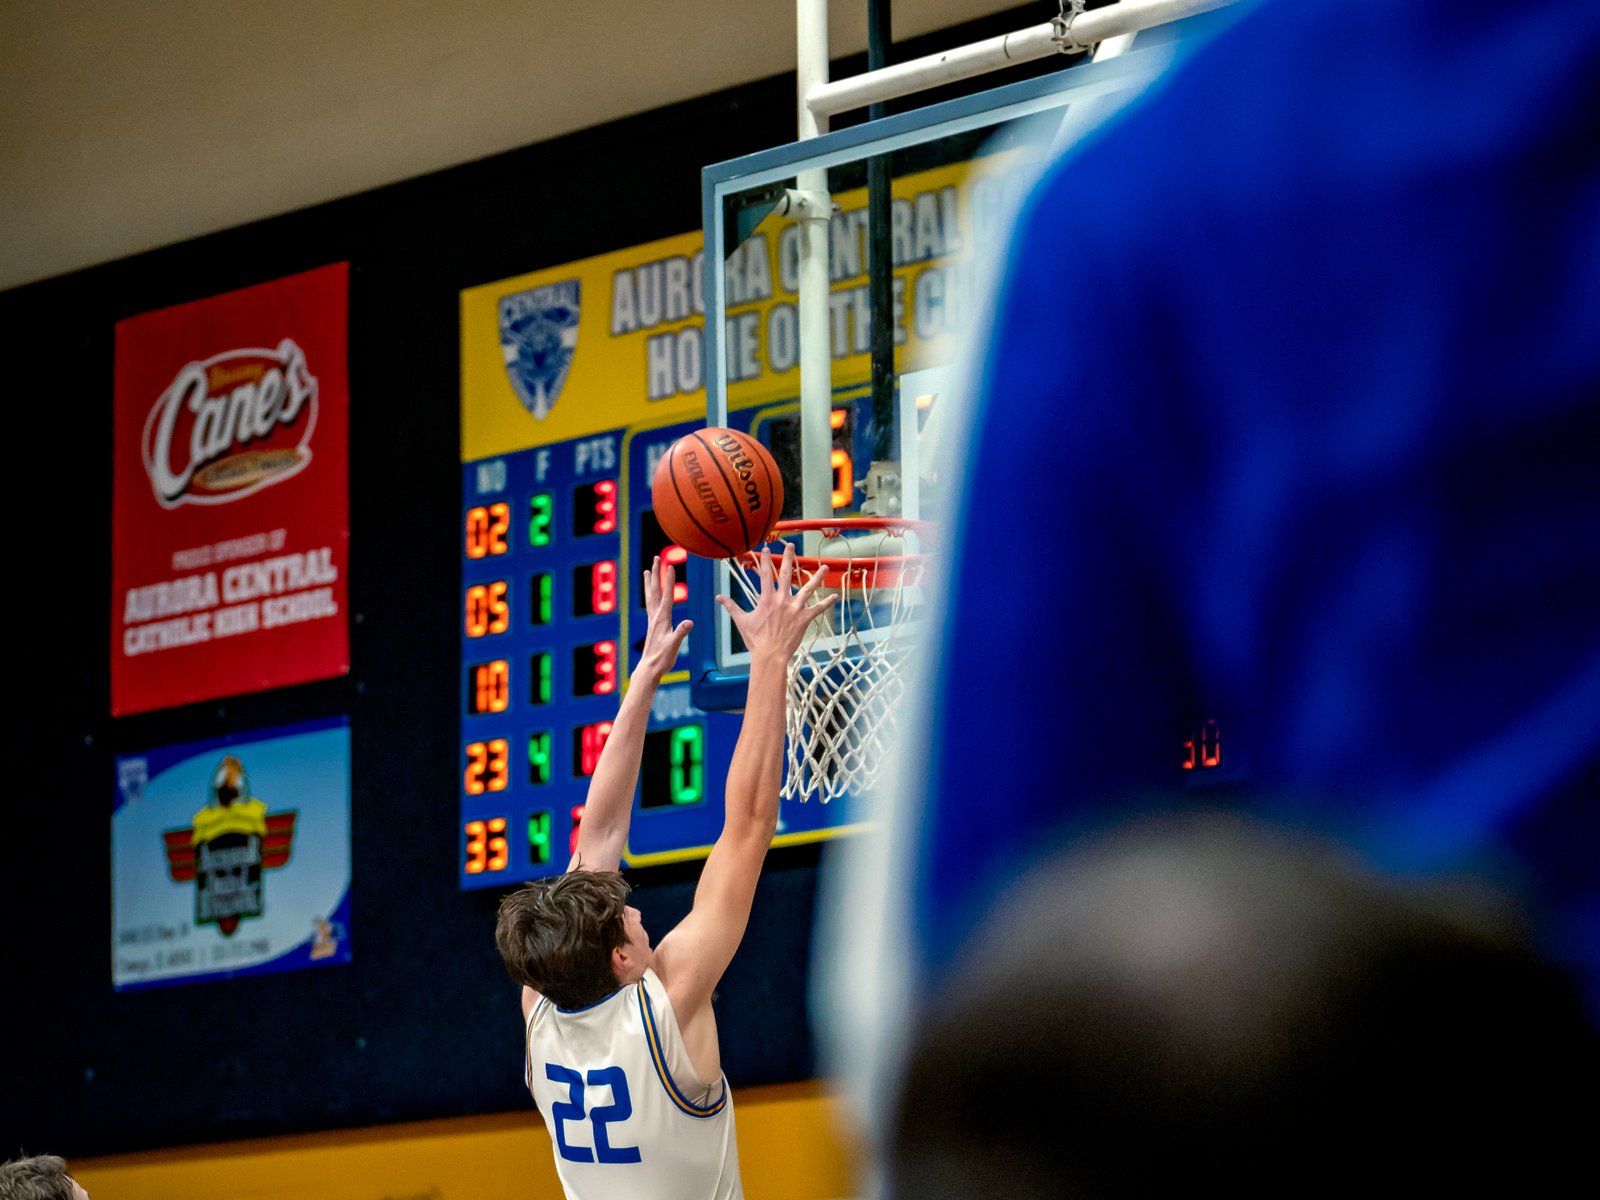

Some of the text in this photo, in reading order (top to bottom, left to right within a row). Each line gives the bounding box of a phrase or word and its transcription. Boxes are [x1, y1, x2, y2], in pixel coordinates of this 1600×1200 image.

[779, 185, 965, 295] CNTRAL
[535, 450, 550, 482] F
[575, 436, 617, 475] PTS
[683, 451, 730, 525] EVOLUTION
[714, 433, 762, 513] Wilson
[465, 479, 617, 558] 02 2 3
[123, 612, 213, 656] CATHOLIC
[261, 586, 338, 629] SCHOOL
[124, 546, 338, 624] AURORA CENTRAL
[465, 581, 509, 637] 05
[540, 574, 552, 624] 1
[592, 559, 617, 614] 8
[476, 640, 617, 713] 10 1 3
[464, 738, 509, 795] 23
[528, 734, 551, 781] 4
[670, 724, 703, 804] 0
[528, 813, 551, 862] 4
[545, 1062, 642, 1164] 22
